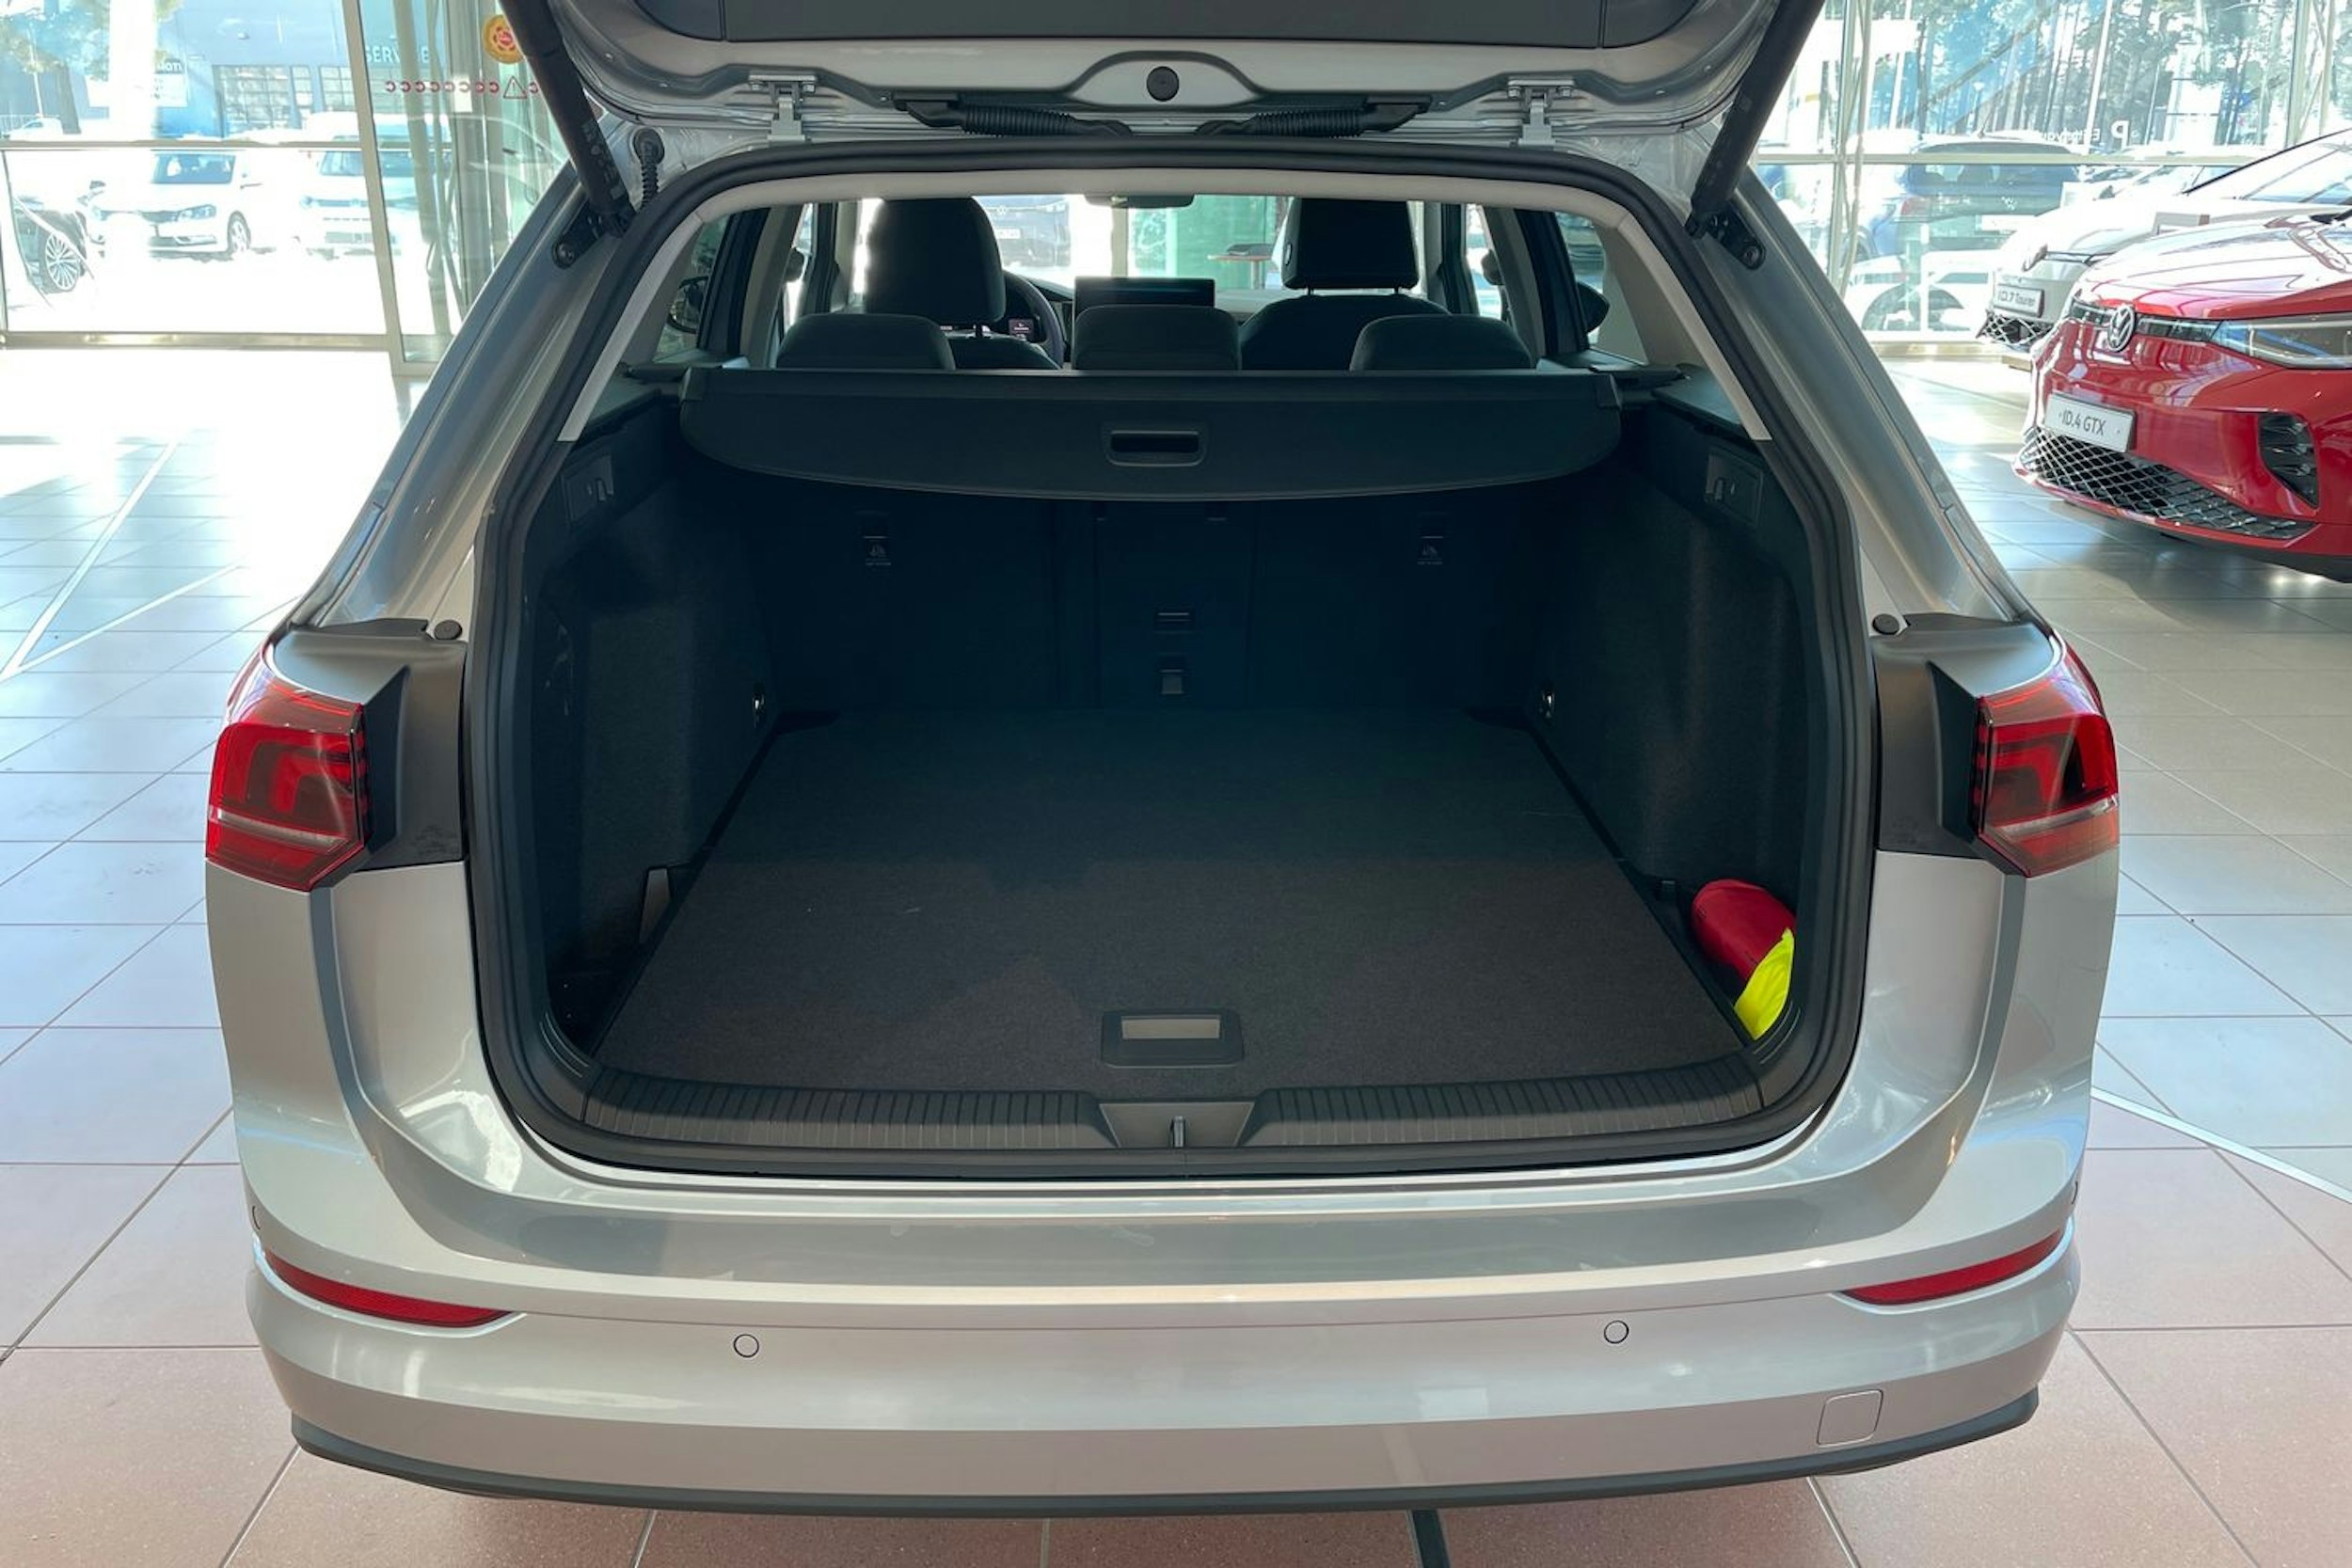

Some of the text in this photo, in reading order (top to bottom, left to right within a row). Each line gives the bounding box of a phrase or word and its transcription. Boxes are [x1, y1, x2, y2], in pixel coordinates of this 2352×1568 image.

[365, 45, 429, 63] SERVE
[2061, 409, 2106, 436] ID.4 GTX
